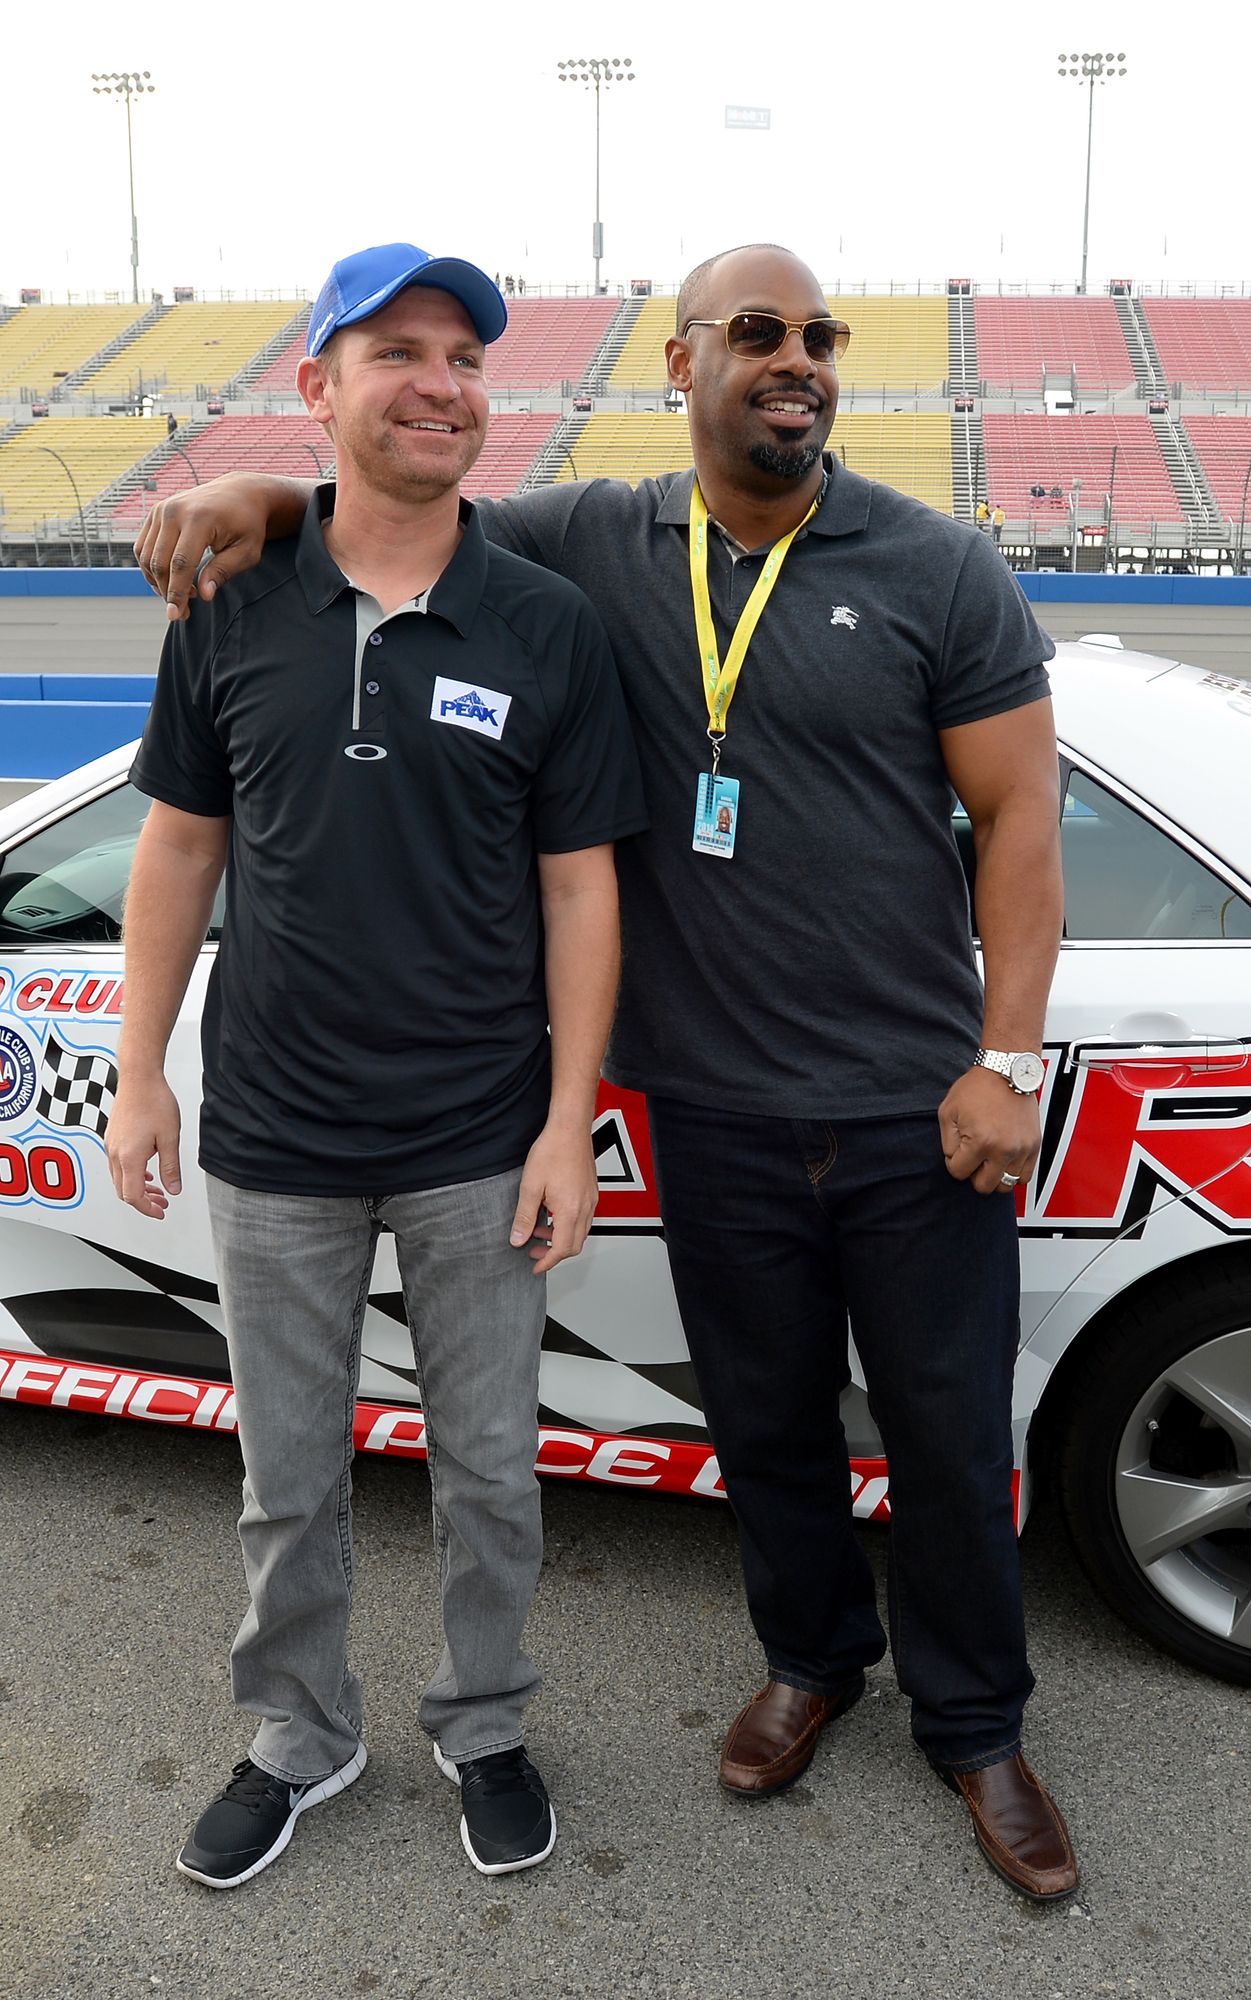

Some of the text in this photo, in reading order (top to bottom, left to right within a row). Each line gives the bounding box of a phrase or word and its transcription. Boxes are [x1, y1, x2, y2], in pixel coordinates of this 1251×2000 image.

[440, 700, 498, 727] PEAK
[11, 1038, 31, 1066] CLUB
[0, 1358, 671, 1485] FFICI PCE
